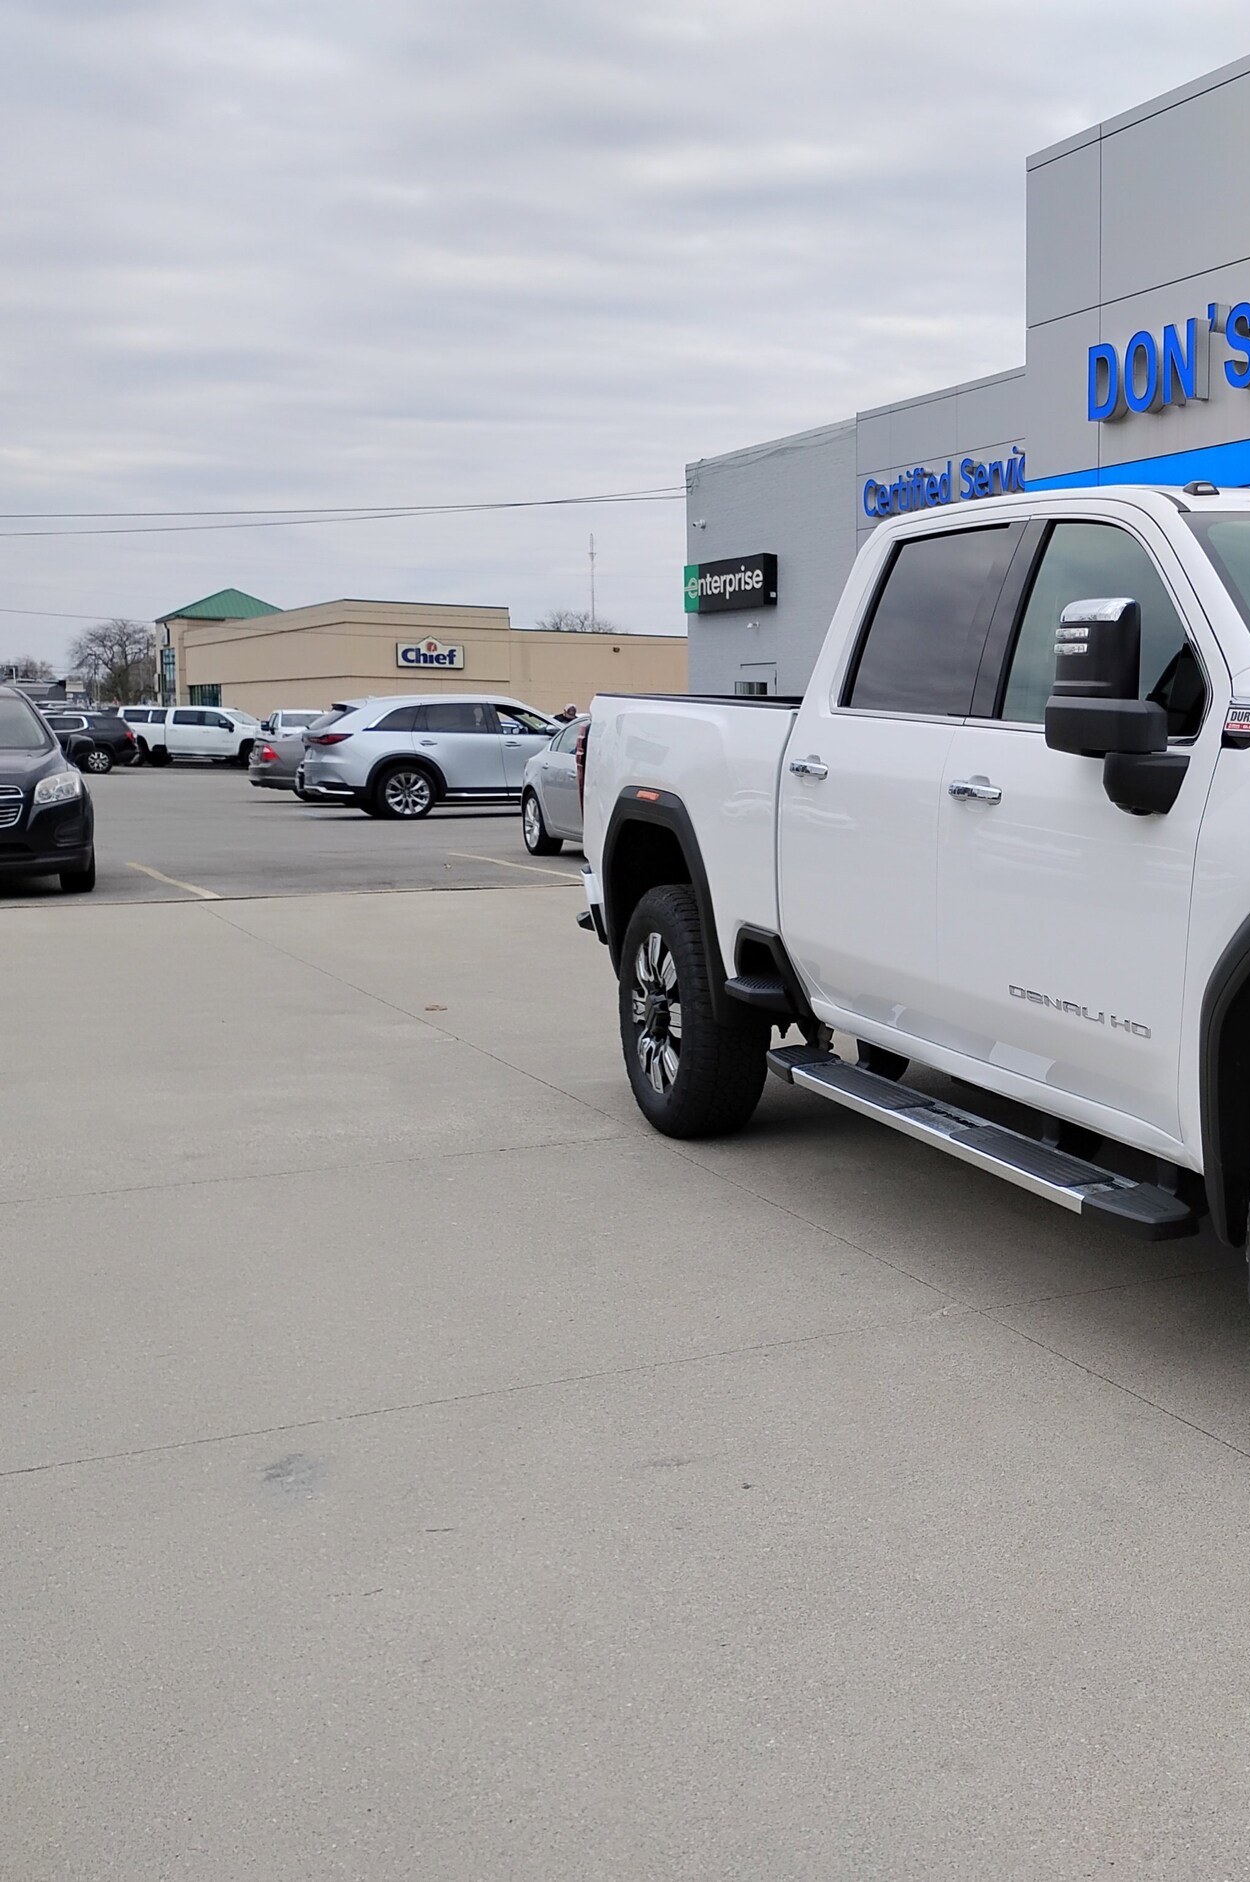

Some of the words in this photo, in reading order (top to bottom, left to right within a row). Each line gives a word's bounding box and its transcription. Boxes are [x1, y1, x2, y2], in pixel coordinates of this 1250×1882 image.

[863, 460, 953, 518] Certified
[684, 564, 764, 600] enterprise
[401, 642, 457, 666] Chief
[1008, 984, 1105, 1025] DENALI
[1110, 1015, 1152, 1039] HD
